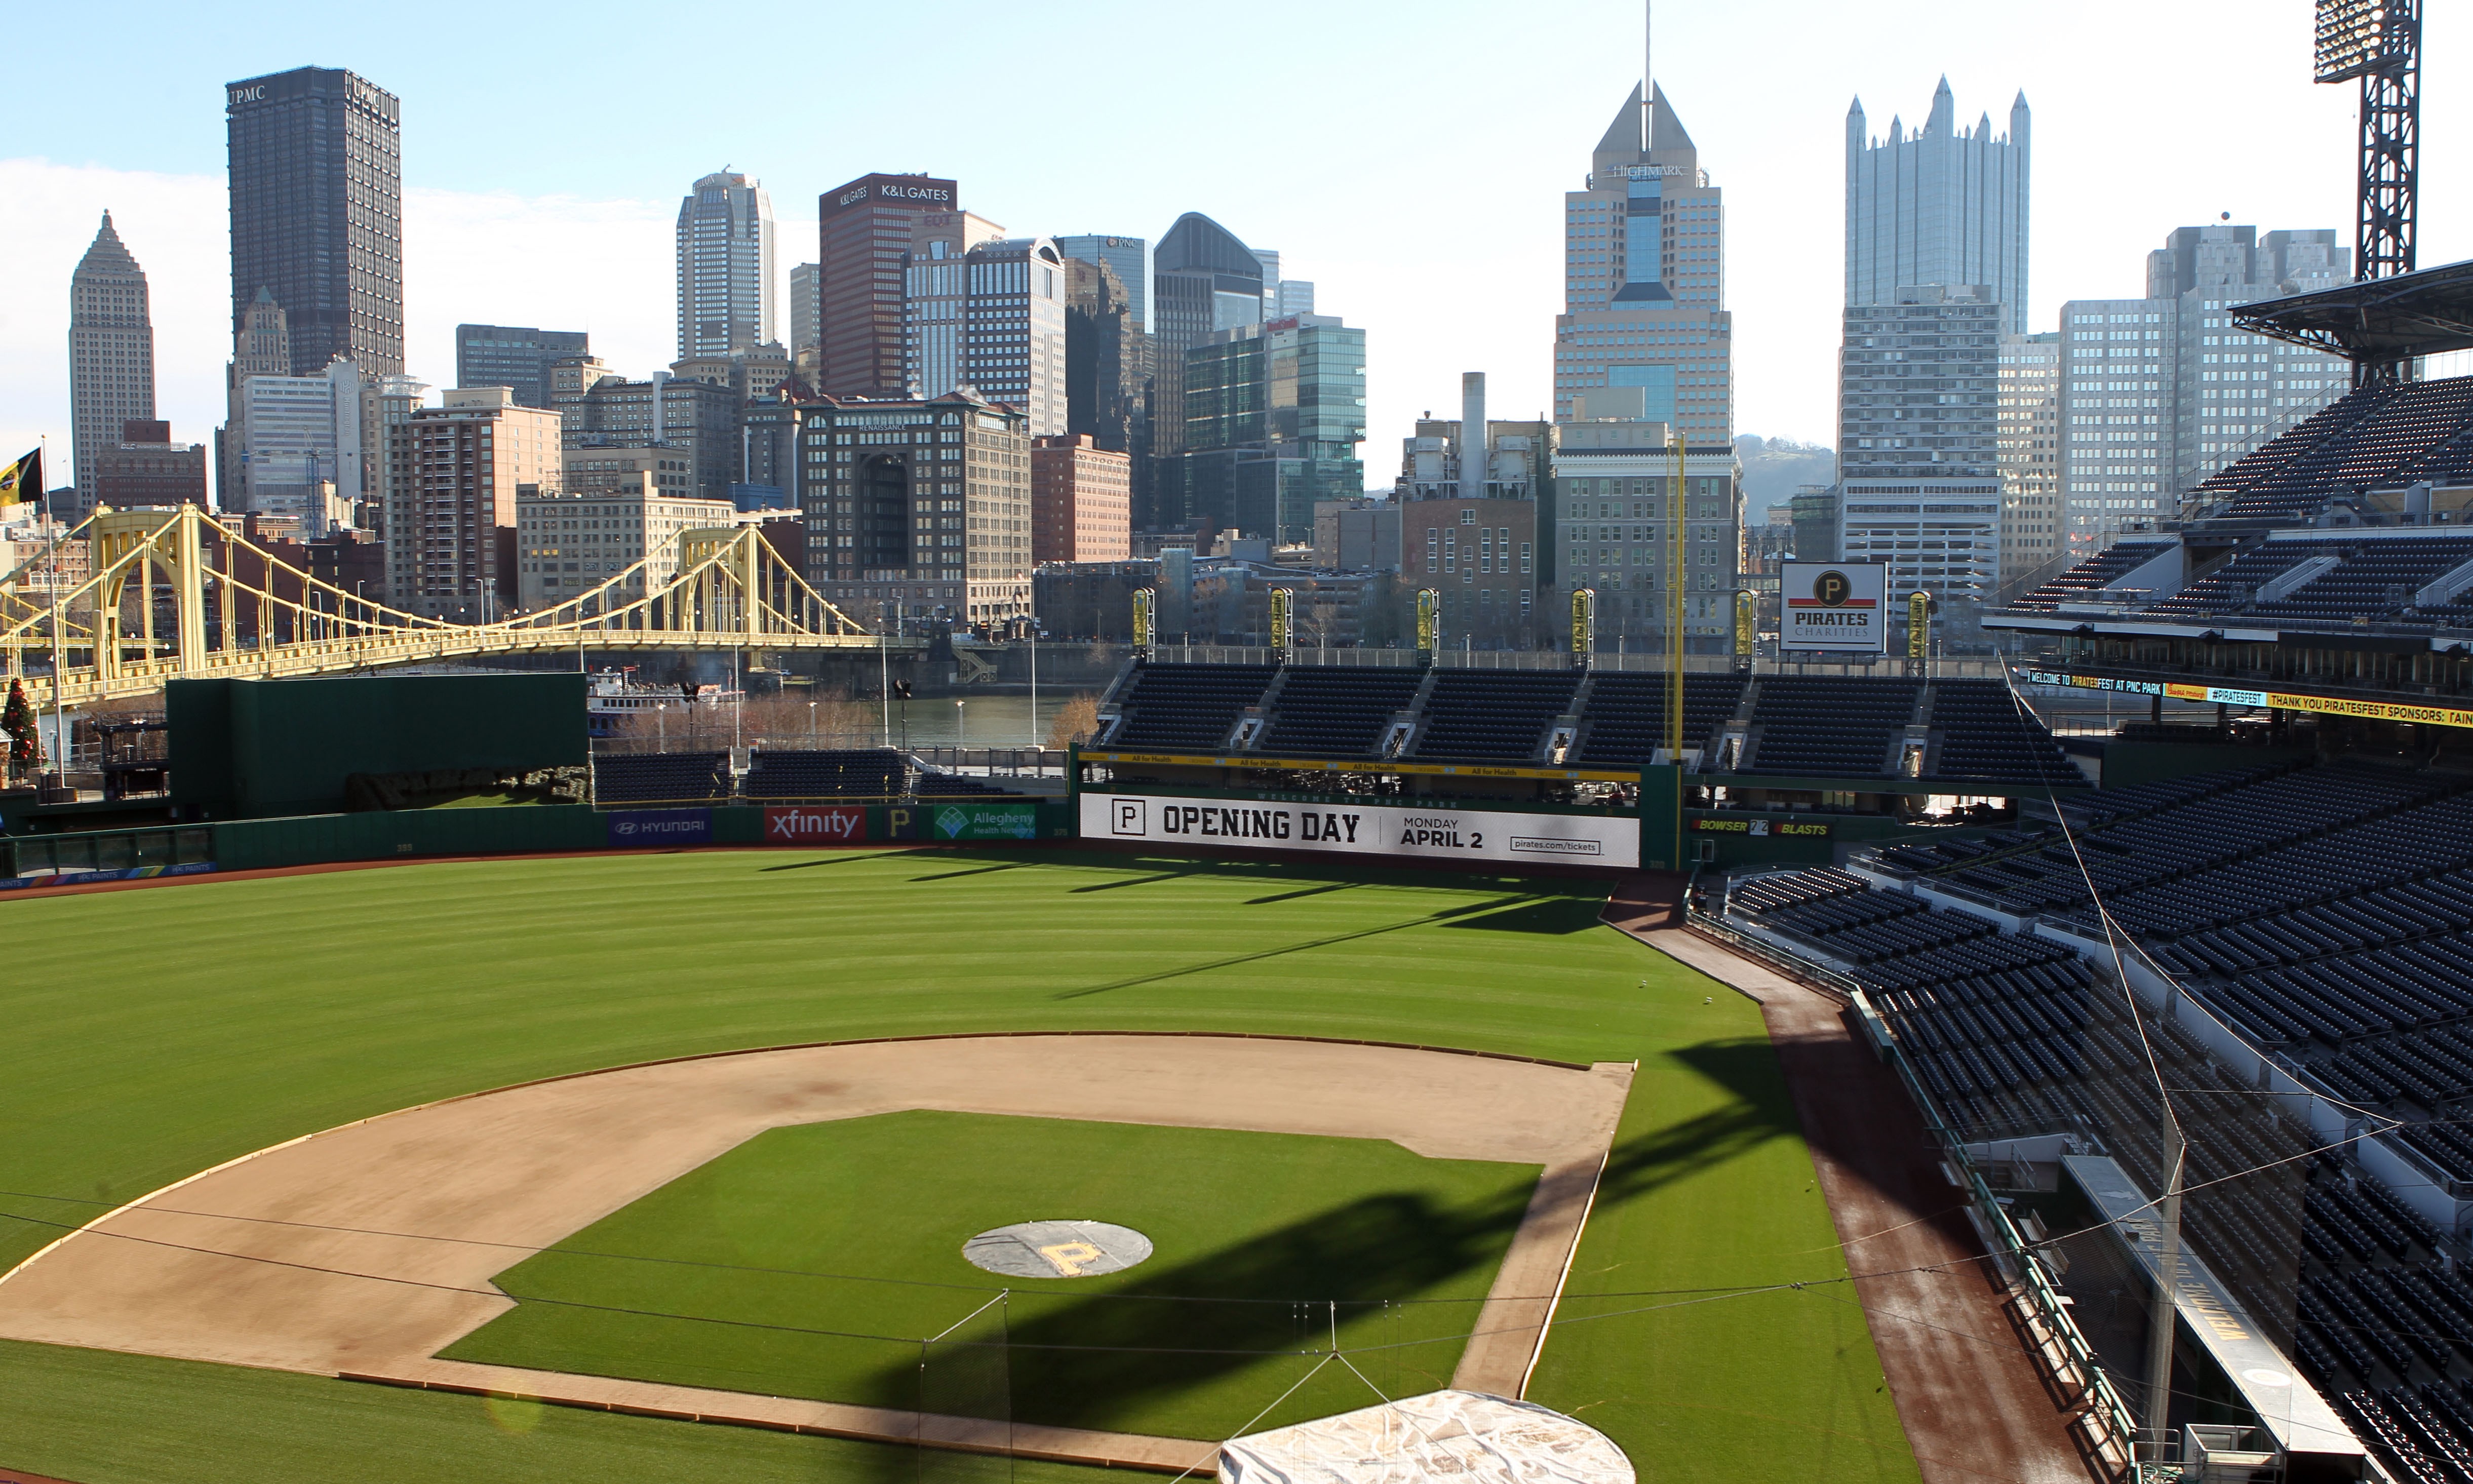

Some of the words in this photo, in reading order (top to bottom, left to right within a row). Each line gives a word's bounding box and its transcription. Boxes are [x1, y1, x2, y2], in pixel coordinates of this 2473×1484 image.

[227, 85, 265, 105] UPMC
[354, 82, 379, 108] UPMC
[1614, 164, 1683, 177] HIGHMARK
[840, 193, 850, 206] K&L
[850, 186, 867, 203] GATES
[882, 185, 905, 198] K&L
[908, 187, 949, 201] GATES
[923, 214, 952, 227] EQT
[1117, 238, 1136, 248] PNC
[1825, 578, 1841, 600] P
[1575, 596, 1584, 622] Health
[1914, 599, 1923, 623] Health
[1795, 613, 1868, 626] PIRATES
[1795, 627, 1868, 637] CHARITIES
[2031, 672, 2060, 685] WELCOME
[2062, 675, 2070, 686] TO
[2071, 675, 2114, 690] PIRATESFEST
[2116, 680, 2124, 691] AT
[2126, 680, 2140, 692] PNC
[2142, 682, 2161, 695] PARK
[2212, 690, 2261, 705] #PIRATESFEST
[2271, 694, 2302, 708] THANK
[2302, 697, 2322, 710] YOU
[2324, 700, 2385, 716] PIRATESFEST
[2387, 706, 2445, 722] SPONSORS:
[1261, 759, 1281, 768] Health
[1374, 764, 1396, 772] Health
[1494, 768, 1517, 776] Health
[1258, 793, 1331, 803] WELCOME
[1375, 798, 1403, 806] PNC
[1417, 800, 1458, 809] PARK
[642, 821, 704, 833] HYUNDAI
[772, 809, 858, 838] xfinity
[890, 809, 910, 837] P
[973, 812, 1034, 826] Allegheny
[1164, 805, 1290, 839] OPENING
[1302, 812, 1360, 843] DAY
[1404, 817, 1458, 829] MONDAY
[973, 827, 999, 835] Health
[1001, 827, 1035, 835] Network
[1699, 820, 1748, 832] BOWSER
[1781, 824, 1828, 836] BLASTS
[1400, 829, 1464, 848] APRIL
[1470, 832, 1483, 849] 2
[1515, 840, 1595, 851] pirates.com/tickets
[92, 872, 118, 880] PAINTS
[2177, 1281, 2250, 1341] WELCOME
